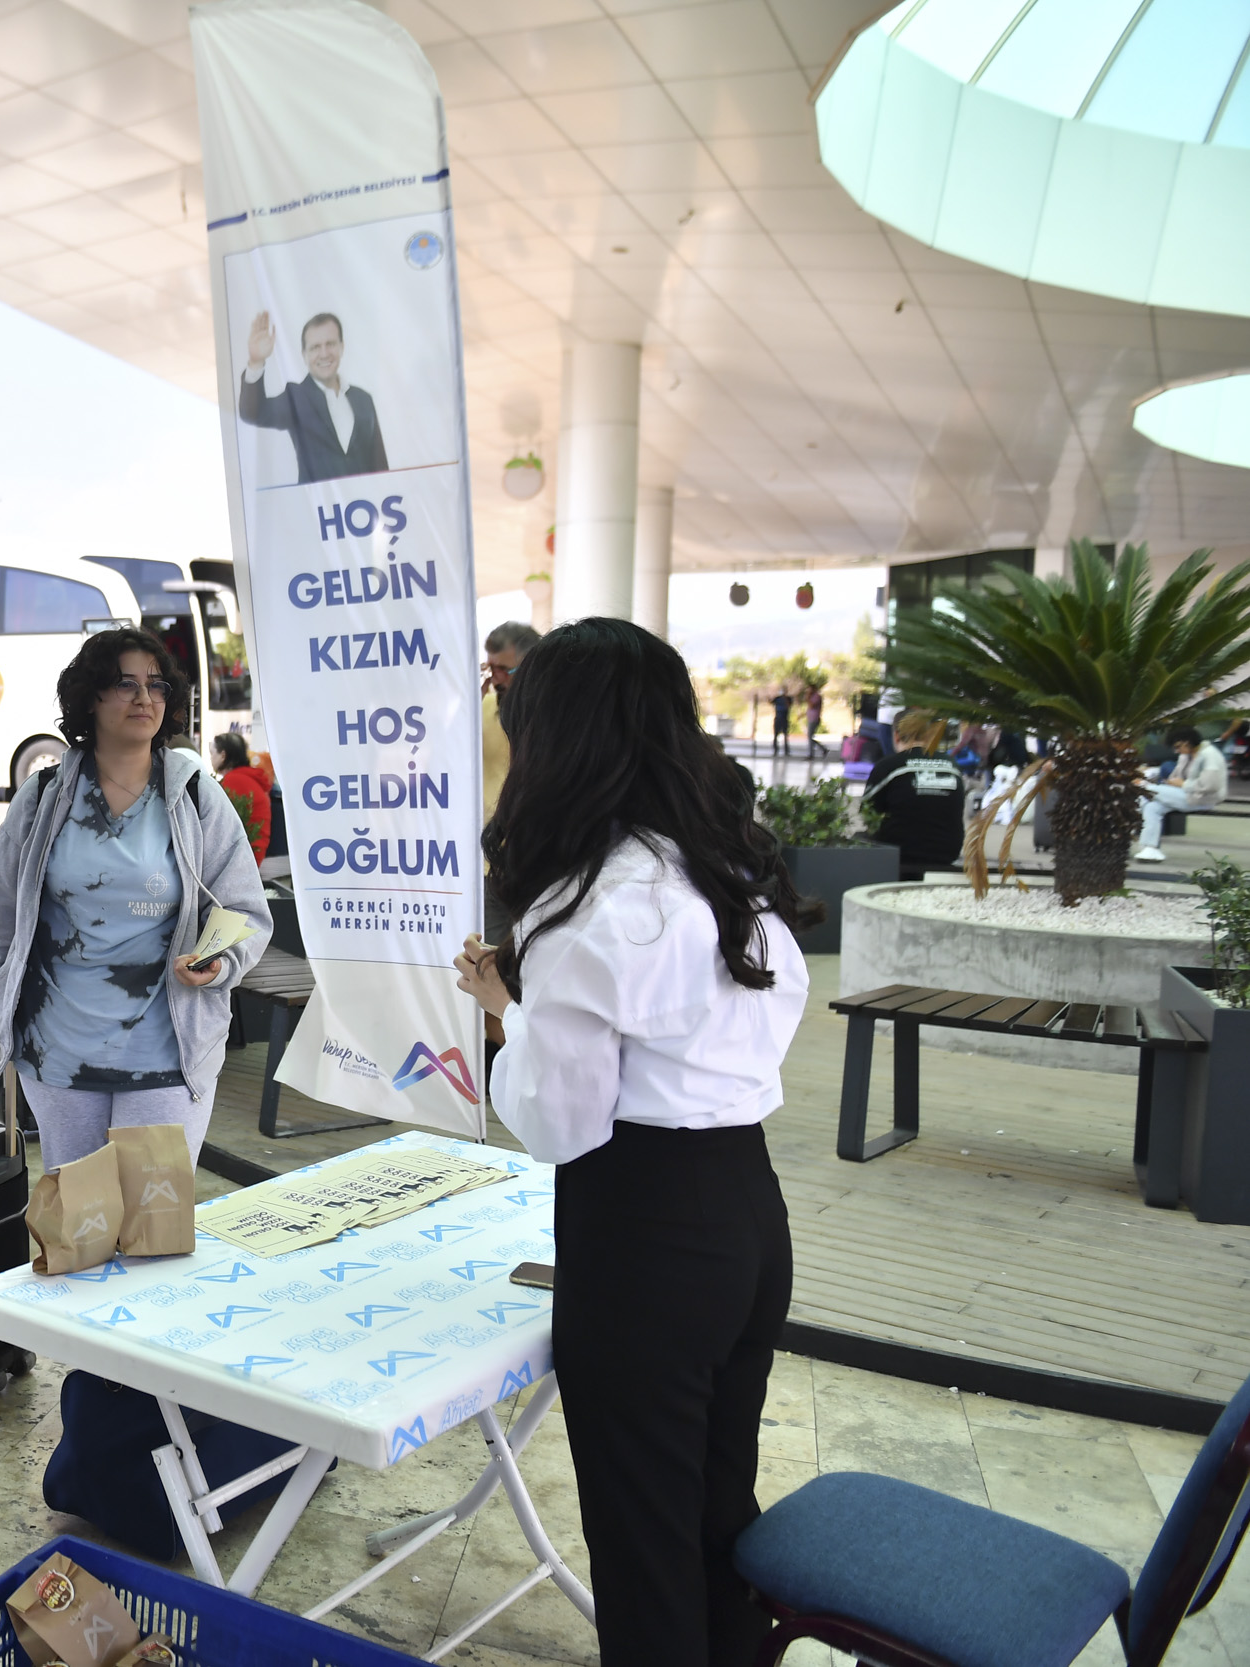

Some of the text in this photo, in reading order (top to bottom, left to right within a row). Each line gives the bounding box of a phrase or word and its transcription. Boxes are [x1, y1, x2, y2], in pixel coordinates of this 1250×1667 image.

[269, 198, 301, 216] MERSİN
[303, 184, 361, 206] BÜYÜKŞEHİR
[364, 174, 416, 193] BELEDİYESİ
[317, 496, 407, 546] HOŞ
[288, 551, 438, 610] GELDİN
[309, 628, 441, 673] KIZIM,
[337, 706, 426, 756] HOŞ
[302, 760, 449, 812] GELDİN
[307, 827, 460, 878] OĞLUM
[322, 898, 446, 918] ÖĞRENCİ DOSTU
[330, 915, 443, 935] MERSİN SENİN
